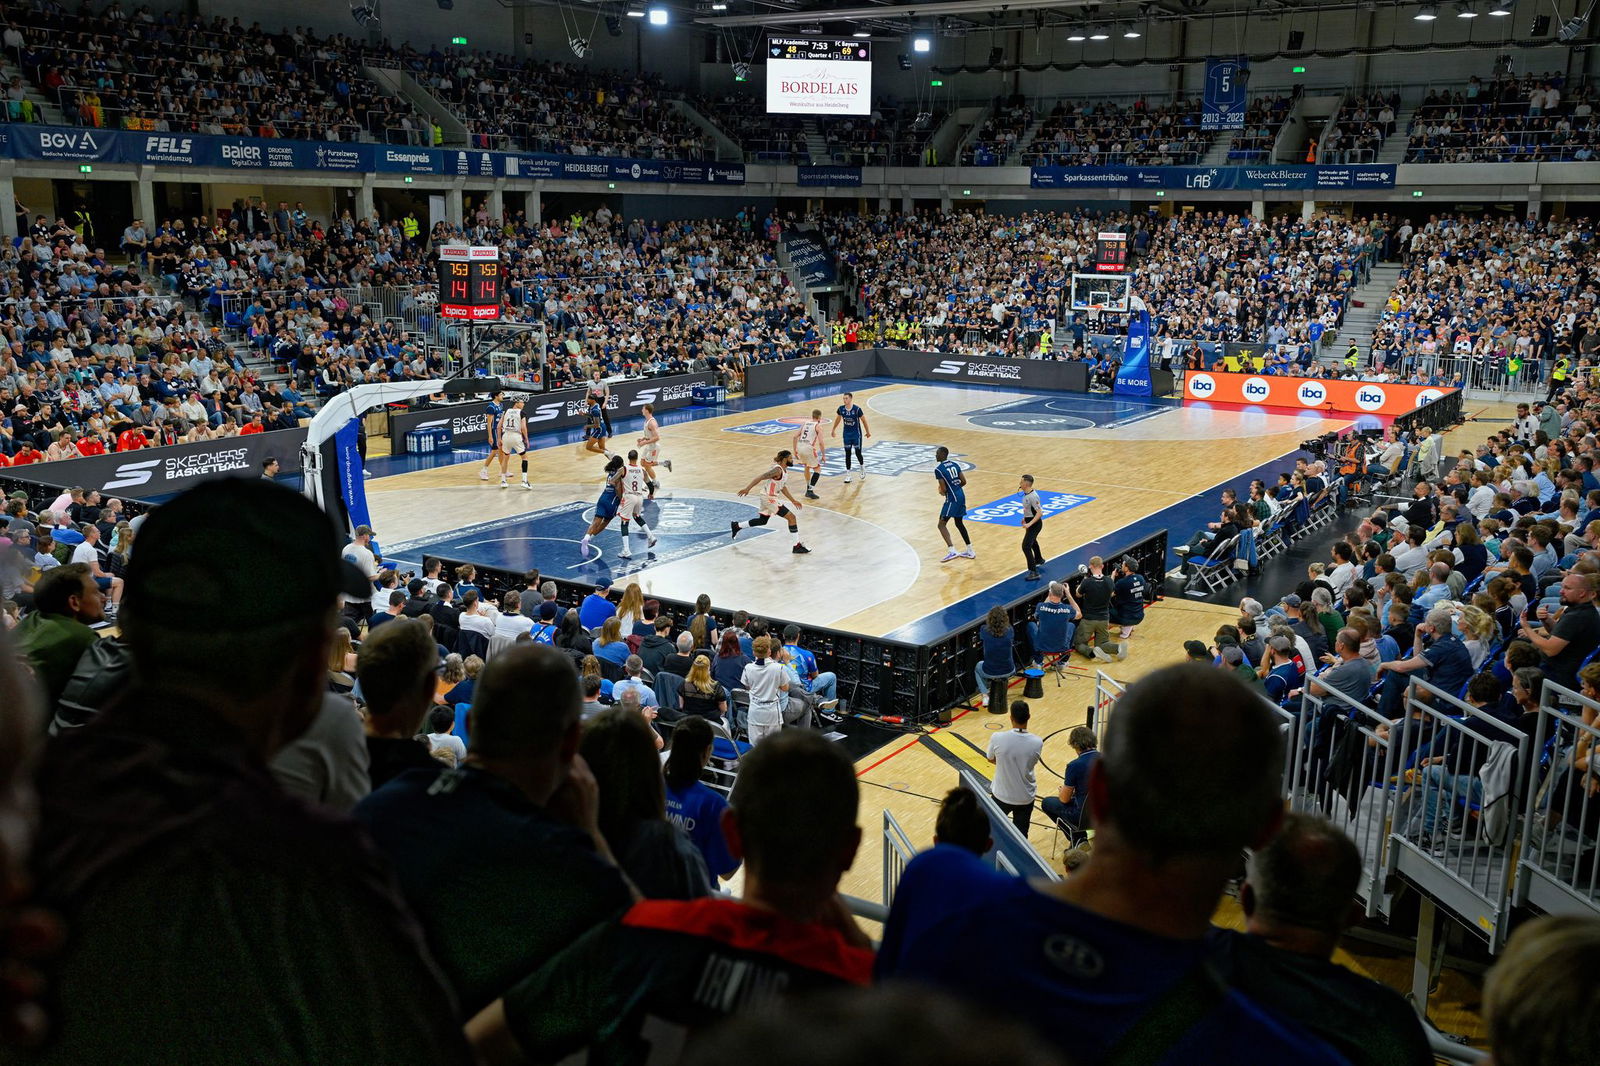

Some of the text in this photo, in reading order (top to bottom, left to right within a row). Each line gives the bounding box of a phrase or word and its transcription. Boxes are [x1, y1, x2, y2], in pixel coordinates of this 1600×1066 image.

[812, 42, 828, 50] 7:53
[781, 82, 858, 95] BORDELAIS
[1222, 76, 1230, 92] 5
[1202, 113, 1220, 122] 2013
[1226, 112, 1244, 122] 2023
[40, 133, 76, 148] BGV
[146, 136, 192, 154] FELS
[146, 154, 192, 164] #wirsindumzug
[328, 150, 359, 159] Purzelzwerg
[386, 151, 430, 166] Essenpreis
[564, 164, 602, 173] HEIDELBERG
[1064, 174, 1128, 182] Sparkassentribüne
[1246, 170, 1308, 180] Weber&Bletzer
[1104, 251, 1115, 260] 14
[452, 281, 466, 298] 14
[481, 281, 496, 298] 14
[446, 306, 467, 316] tipico
[474, 307, 496, 316] tipico
[810, 368, 842, 378] BASKETBALL
[811, 362, 842, 373] SKECHERS
[968, 362, 1021, 374] SKECHERS
[968, 370, 1022, 379] BASKETBALL
[1192, 379, 1212, 392] iba
[1246, 383, 1266, 395] iba
[1302, 386, 1322, 399] iba
[1360, 390, 1382, 403] iba
[506, 419, 514, 428] 11
[802, 430, 808, 440] 5
[165, 448, 248, 470] SKECHERS
[166, 460, 250, 480] BASKETBALL
[947, 466, 958, 480] 10
[632, 480, 638, 492] 8
